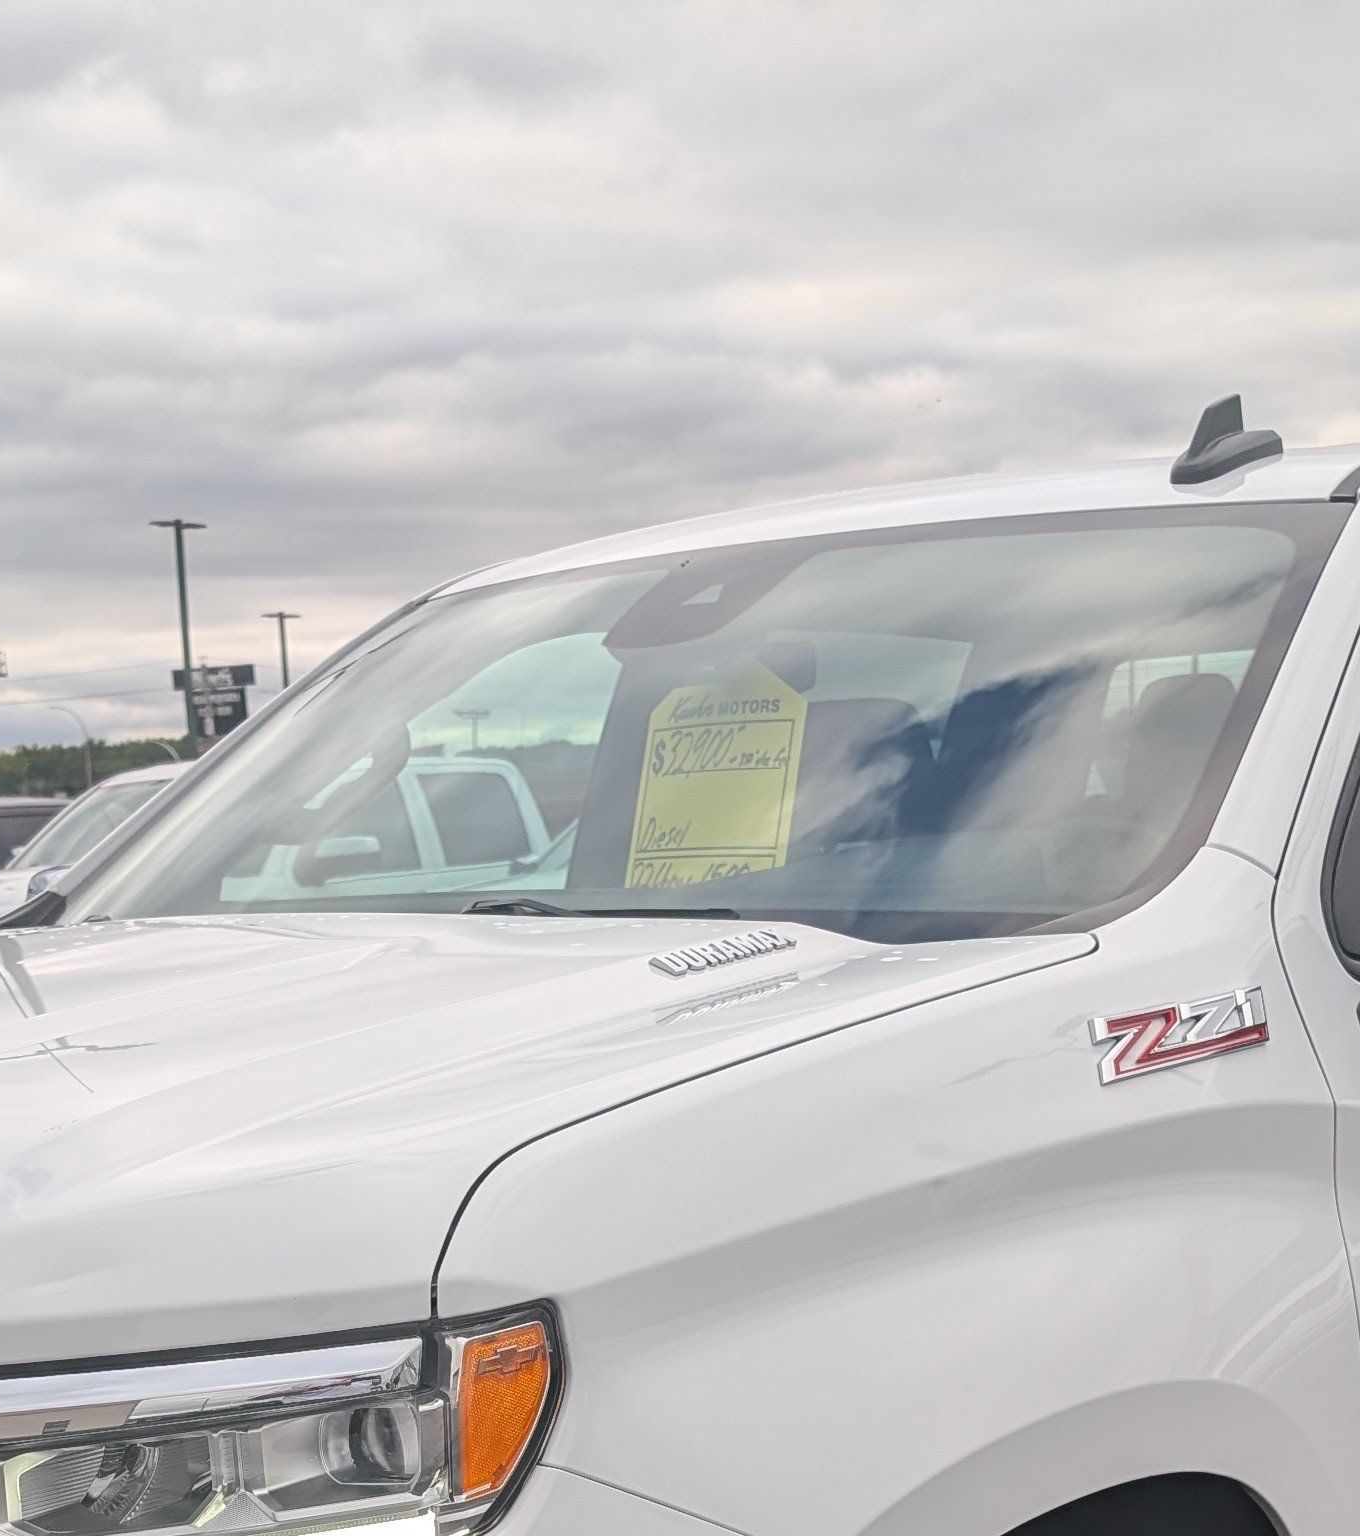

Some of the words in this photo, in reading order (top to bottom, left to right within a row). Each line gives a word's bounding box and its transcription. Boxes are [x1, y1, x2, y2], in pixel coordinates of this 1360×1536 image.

[717, 698, 780, 715] MOTORS
[647, 929, 797, 977] DURAMAX
[1087, 986, 1270, 1087] Z71
